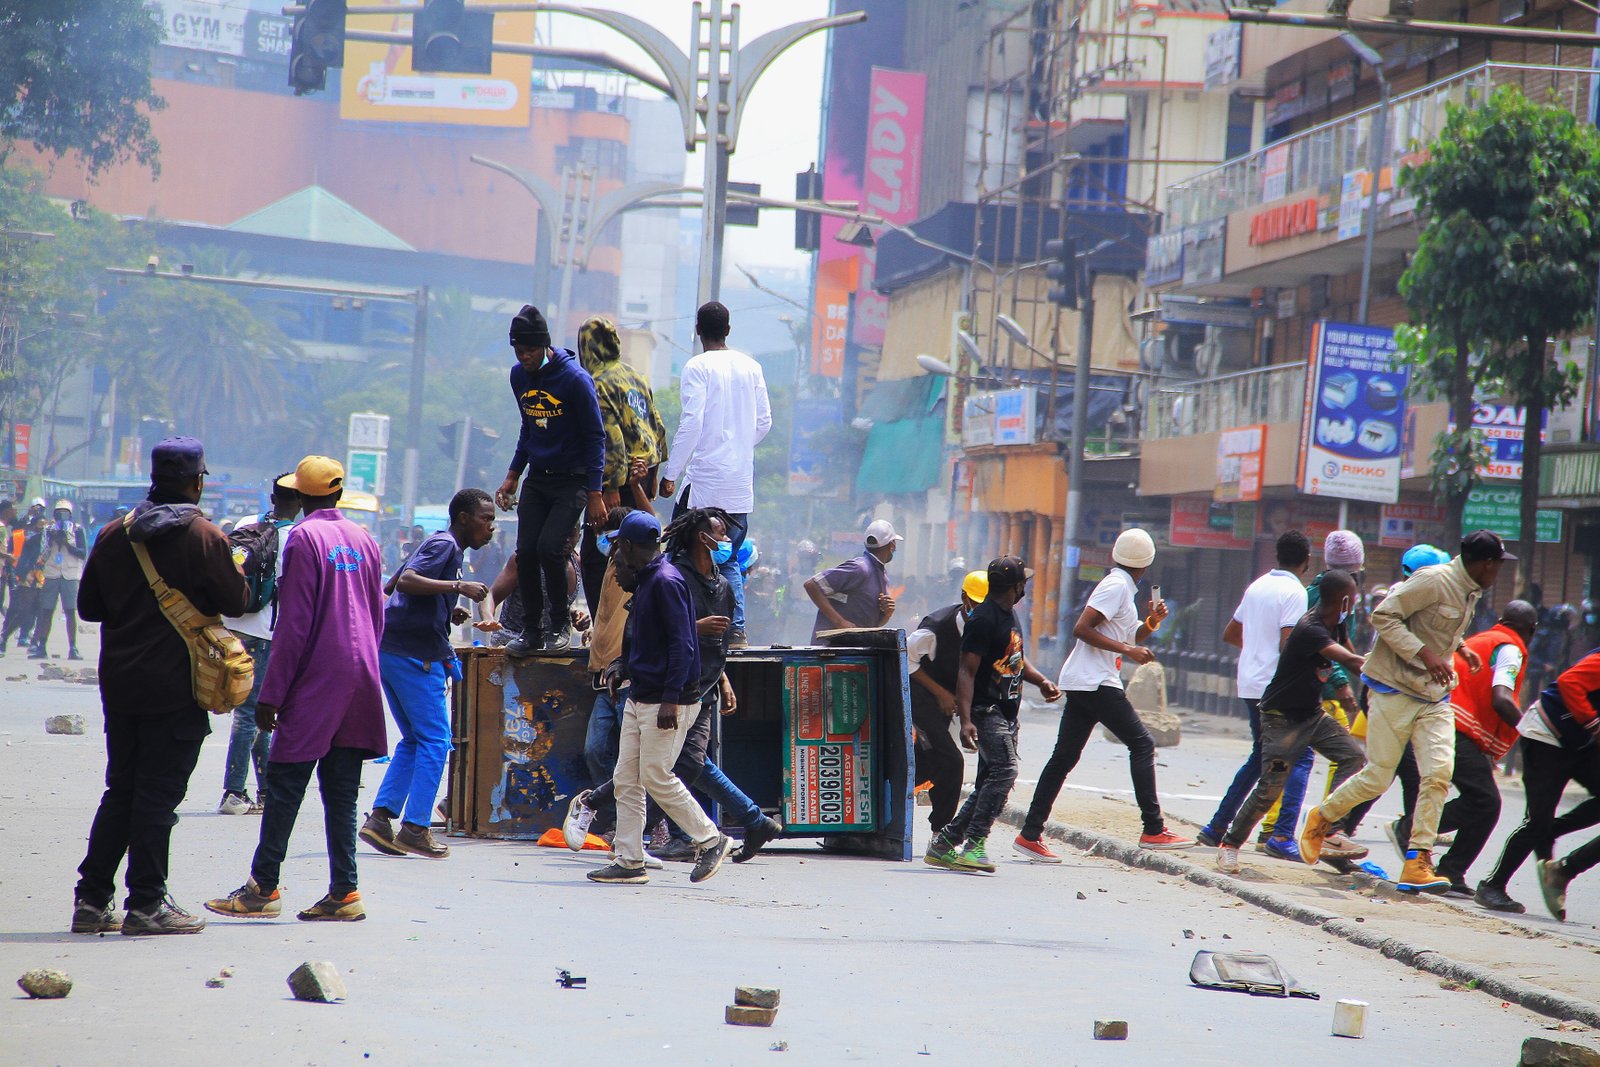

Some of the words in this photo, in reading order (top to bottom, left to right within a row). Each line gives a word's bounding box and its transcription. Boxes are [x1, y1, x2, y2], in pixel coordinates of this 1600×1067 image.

[172, 13, 221, 41] GYM
[258, 19, 286, 38] GET
[858, 85, 909, 332] BLADY
[1348, 331, 1365, 346] ONE
[1341, 464, 1386, 477] RIKKO
[801, 672, 809, 694] LINES
[801, 694, 810, 735] AVAILABLE
[809, 748, 817, 787] AGENT
[820, 746, 841, 823] 2039603
[810, 790, 818, 822] NAME
